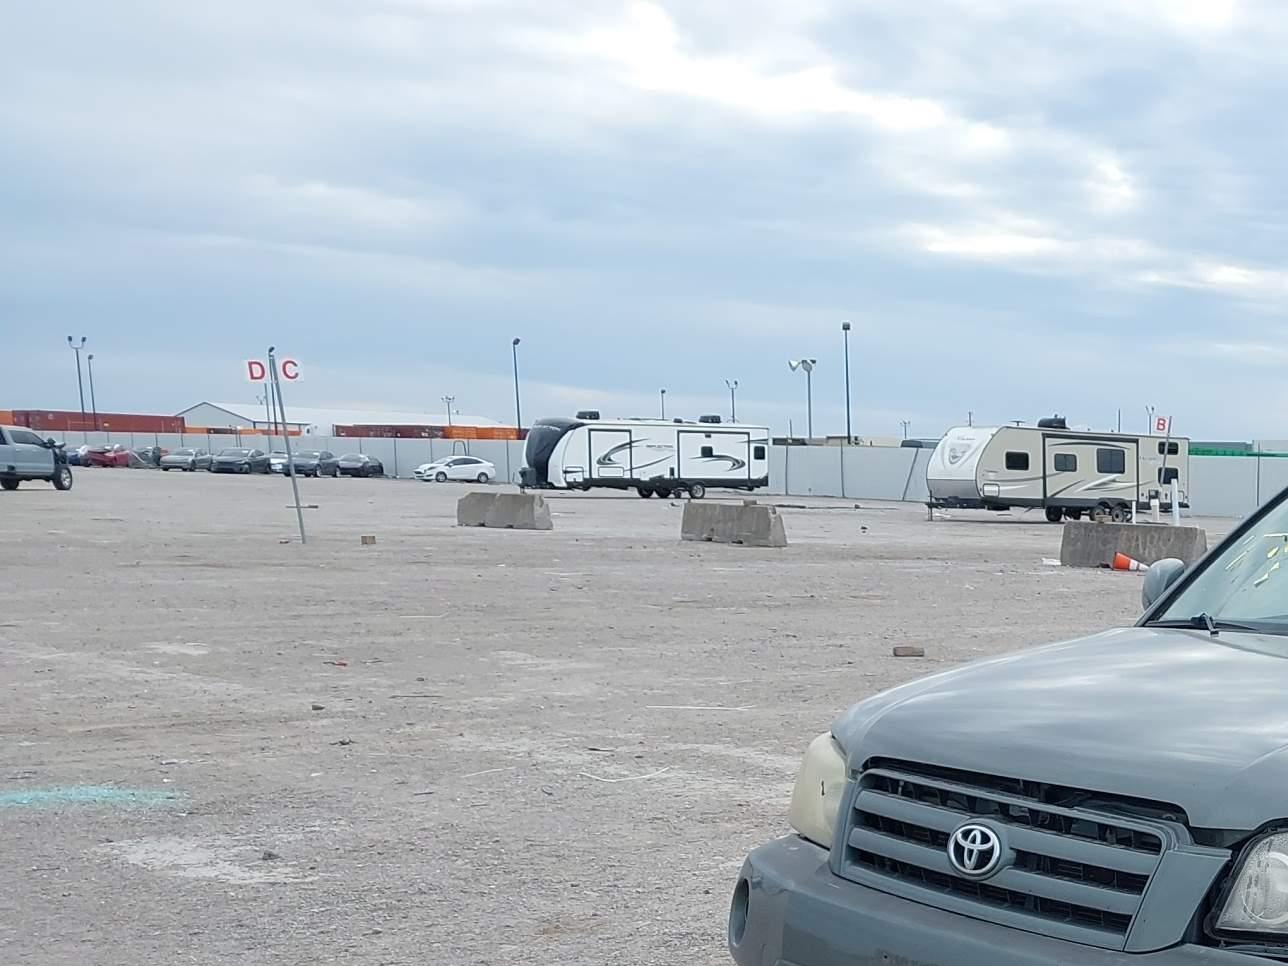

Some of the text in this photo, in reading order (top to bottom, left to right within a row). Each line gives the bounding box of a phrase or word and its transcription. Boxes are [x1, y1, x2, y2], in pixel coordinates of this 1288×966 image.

[248, 361, 265, 380] D
[282, 360, 299, 379] C
[1156, 418, 1167, 431] B
